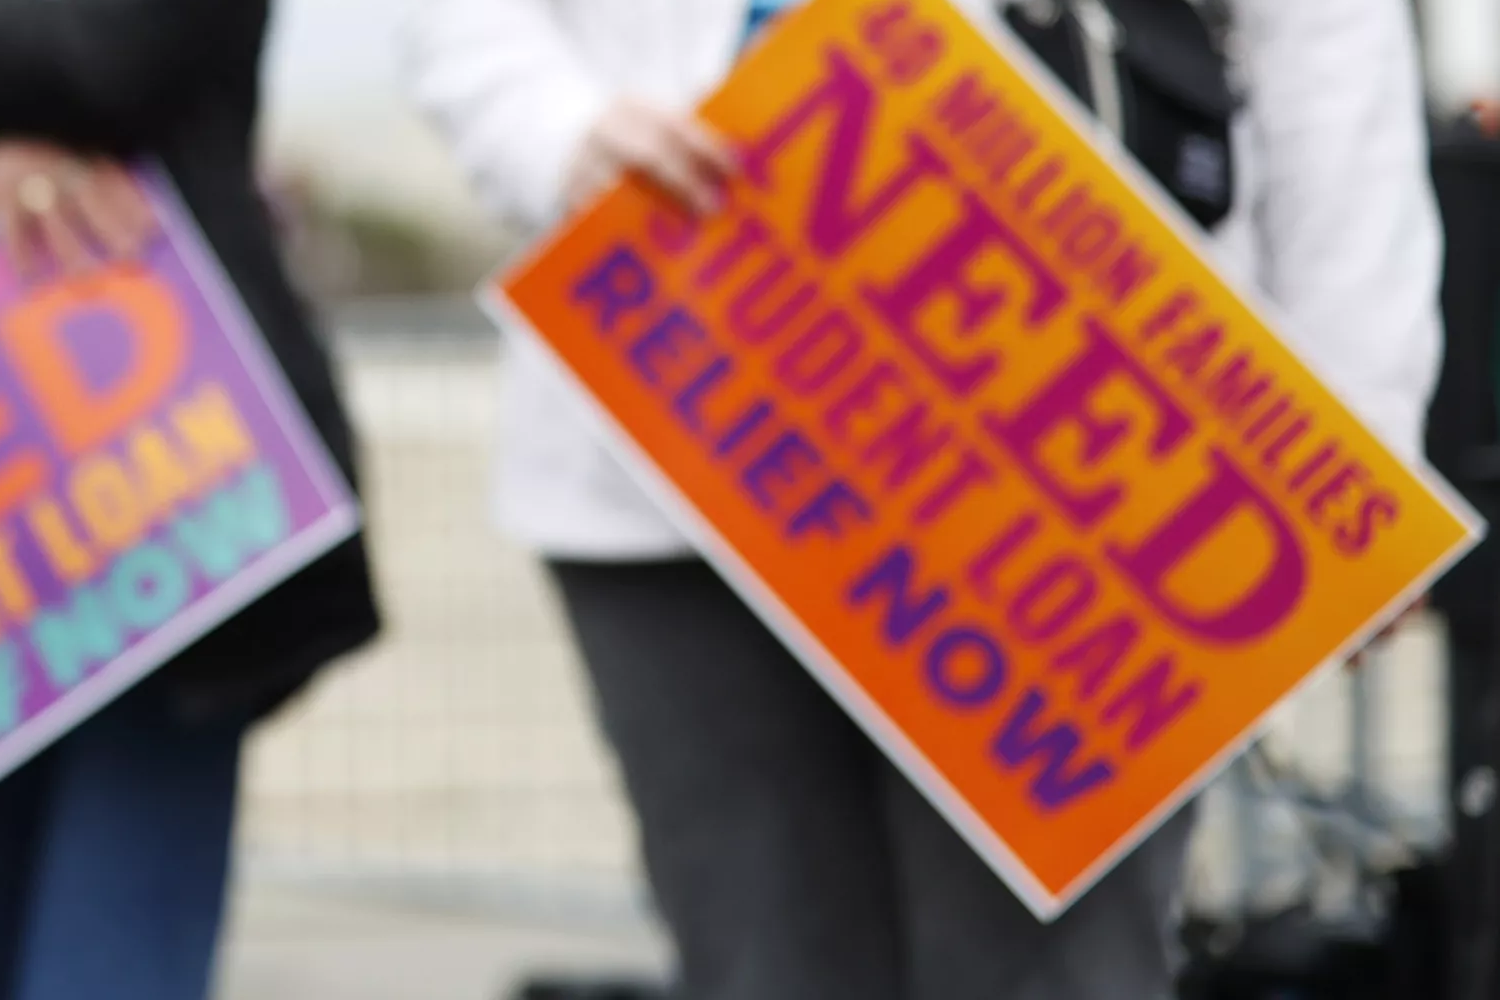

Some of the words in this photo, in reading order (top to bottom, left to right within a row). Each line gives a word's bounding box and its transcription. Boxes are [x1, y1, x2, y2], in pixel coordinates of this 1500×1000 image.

[25, 380, 257, 581] LOAN
[735, 44, 1313, 651] NEED
[926, 68, 1160, 313] MILLION
[1139, 290, 1402, 559] FAMILIES
[32, 463, 288, 684] NOW
[565, 242, 878, 544] RELIEF
[844, 542, 1119, 815] NOW
[964, 509, 1203, 755] LOAN
